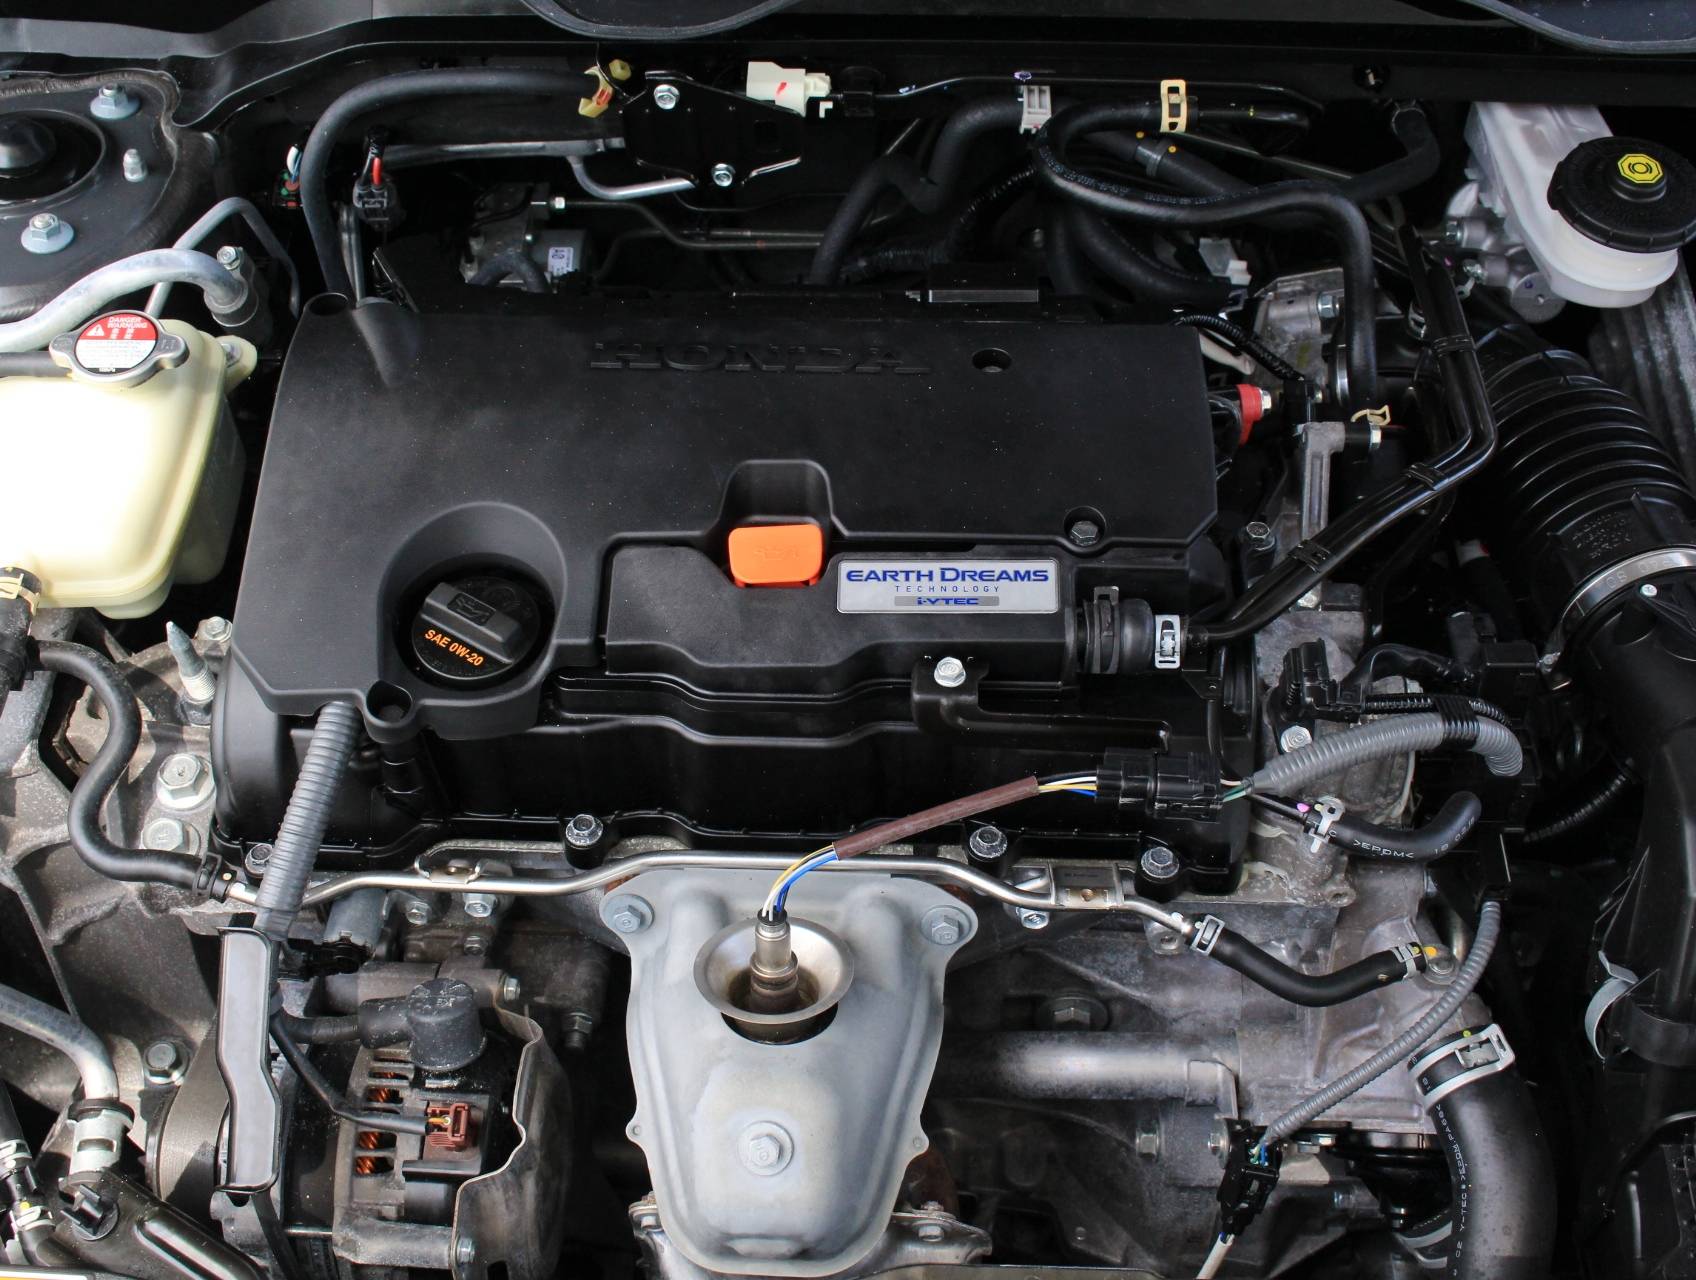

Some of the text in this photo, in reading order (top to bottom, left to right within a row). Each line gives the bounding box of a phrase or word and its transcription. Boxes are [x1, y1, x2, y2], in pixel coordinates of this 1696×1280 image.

[590, 343, 931, 373] HONDA
[846, 567, 1049, 582] EARTH DREAMS
[895, 585, 1000, 593] TECHNOLOGY
[917, 596, 980, 605] i-VTEC
[424, 629, 484, 666] SAE 0W-20
